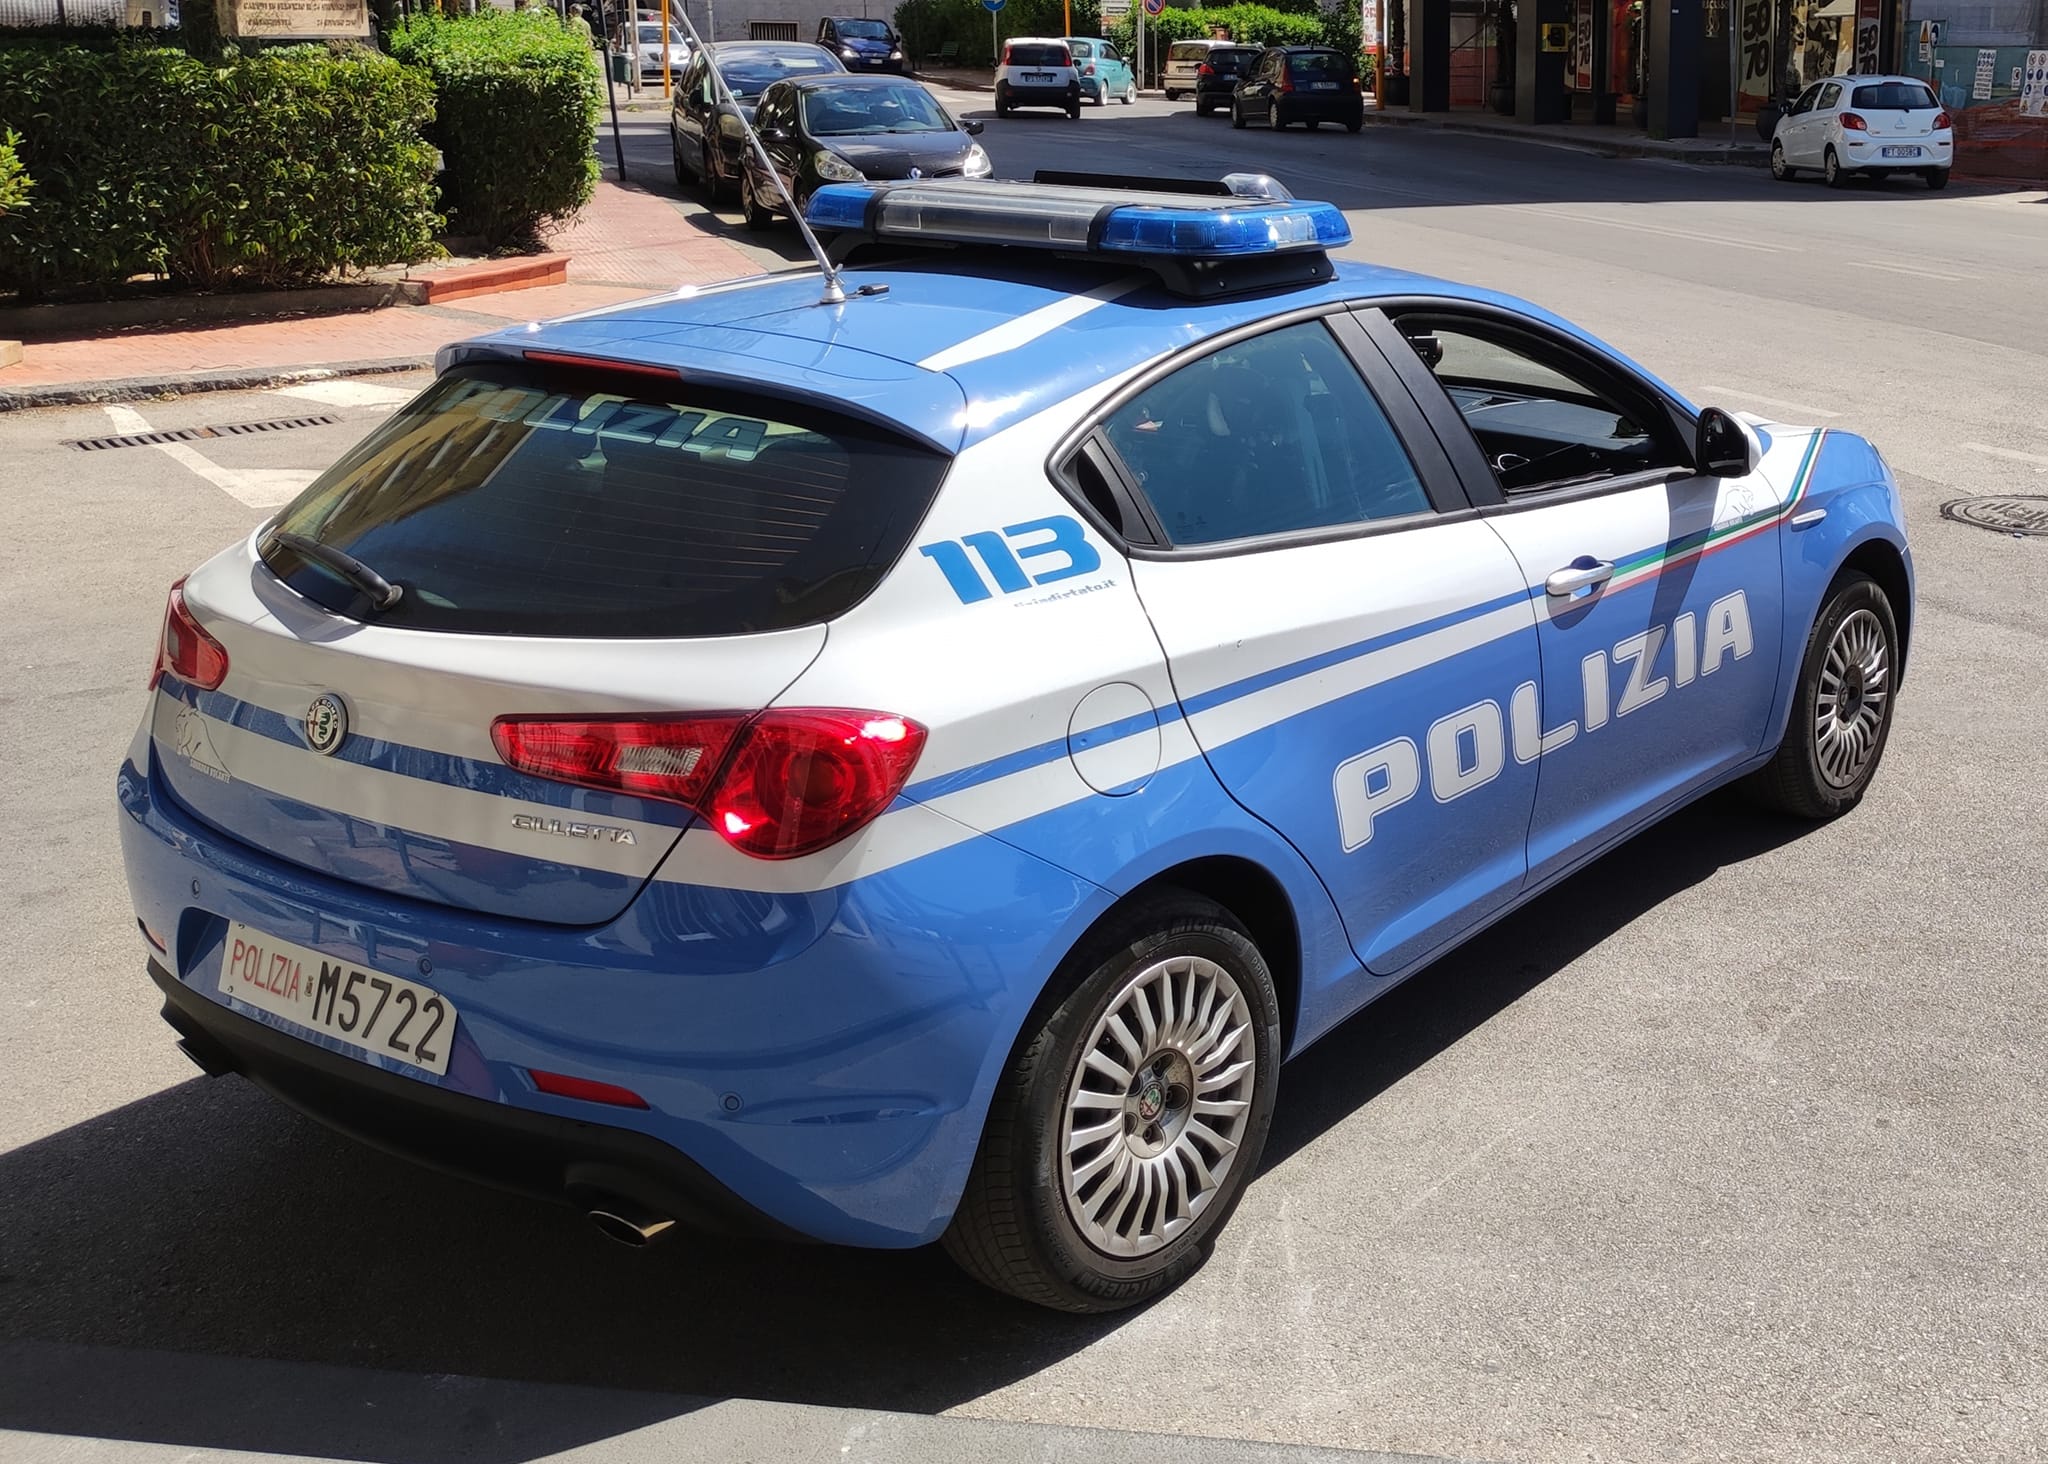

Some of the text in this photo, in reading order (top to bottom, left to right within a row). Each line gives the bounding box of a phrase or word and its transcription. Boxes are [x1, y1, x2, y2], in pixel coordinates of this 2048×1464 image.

[1743, 0, 1771, 41] 50
[1858, 24, 1878, 54] 50
[1744, 40, 1769, 80] 70
[918, 514, 1101, 605] 113
[1332, 589, 1755, 854] POLIZIA
[511, 814, 638, 845] GIULIETTA
[229, 938, 446, 1063] POLIZIA M5722
[1250, 957, 1276, 1007] PRIMACY
[1075, 1270, 1166, 1298] MICHELIN
